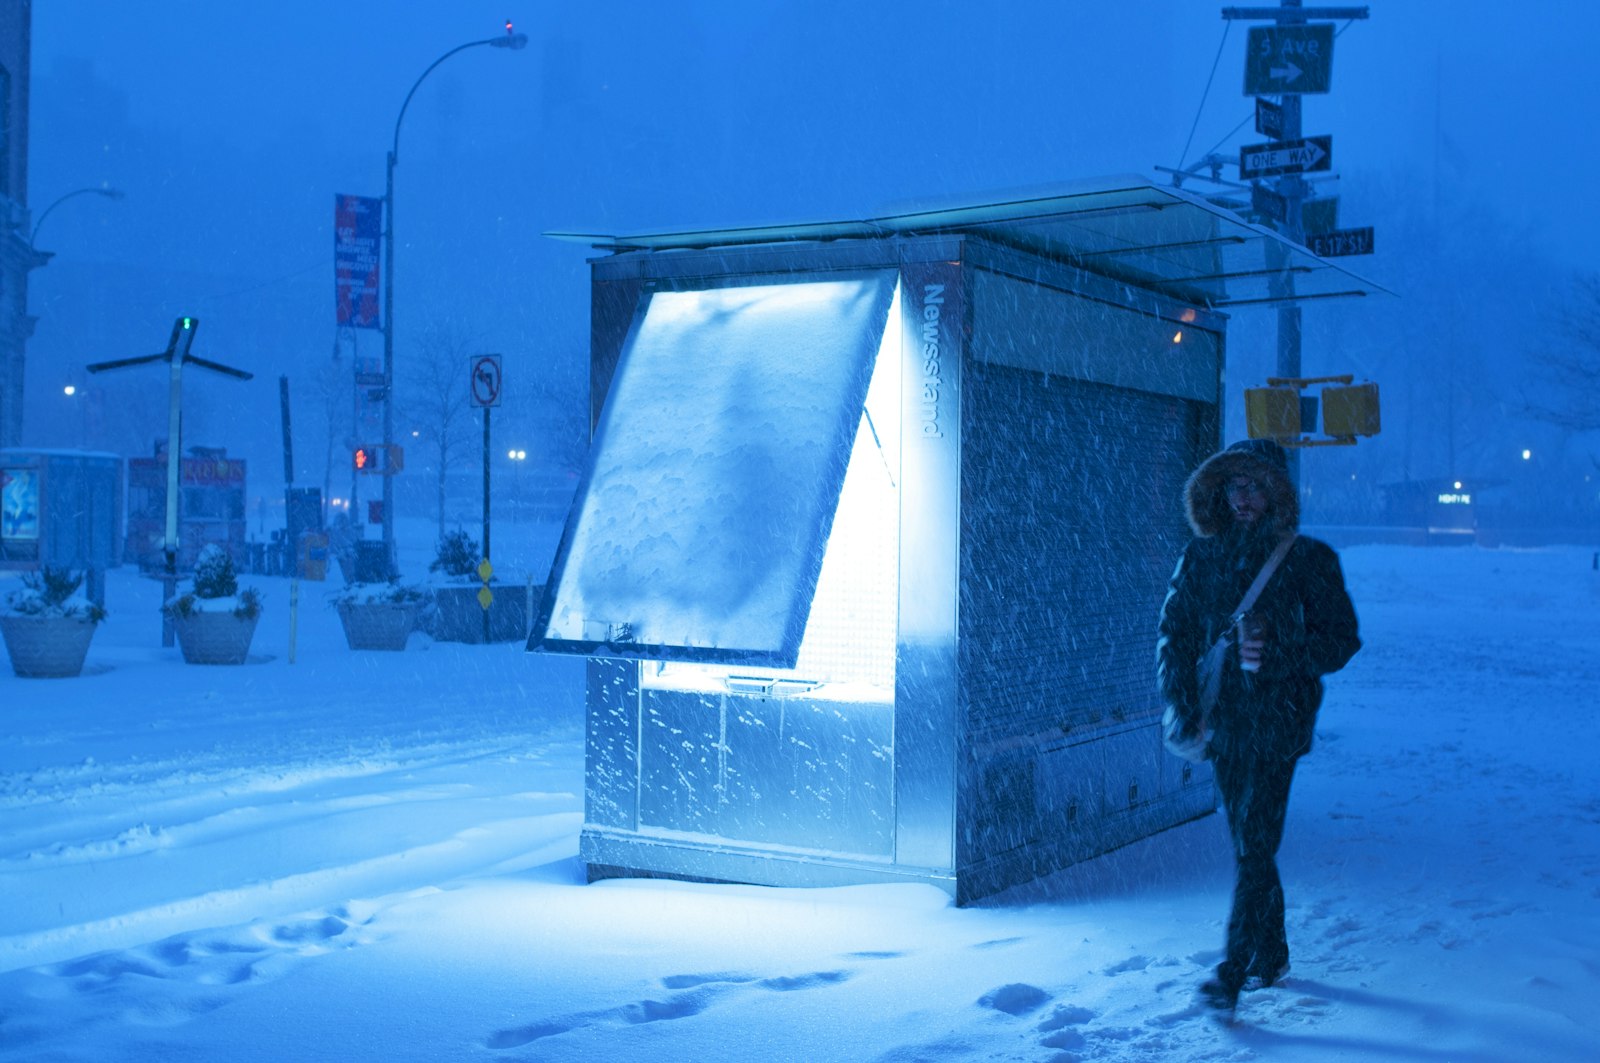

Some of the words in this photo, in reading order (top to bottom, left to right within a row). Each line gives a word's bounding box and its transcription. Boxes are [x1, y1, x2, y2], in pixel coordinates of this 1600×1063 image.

[1281, 37, 1320, 55] Ave
[1251, 151, 1278, 168] ONE
[1288, 147, 1318, 164] WAY
[1314, 238, 1322, 256] E
[1328, 236, 1342, 255] 17
[923, 284, 945, 439] Newsstand
